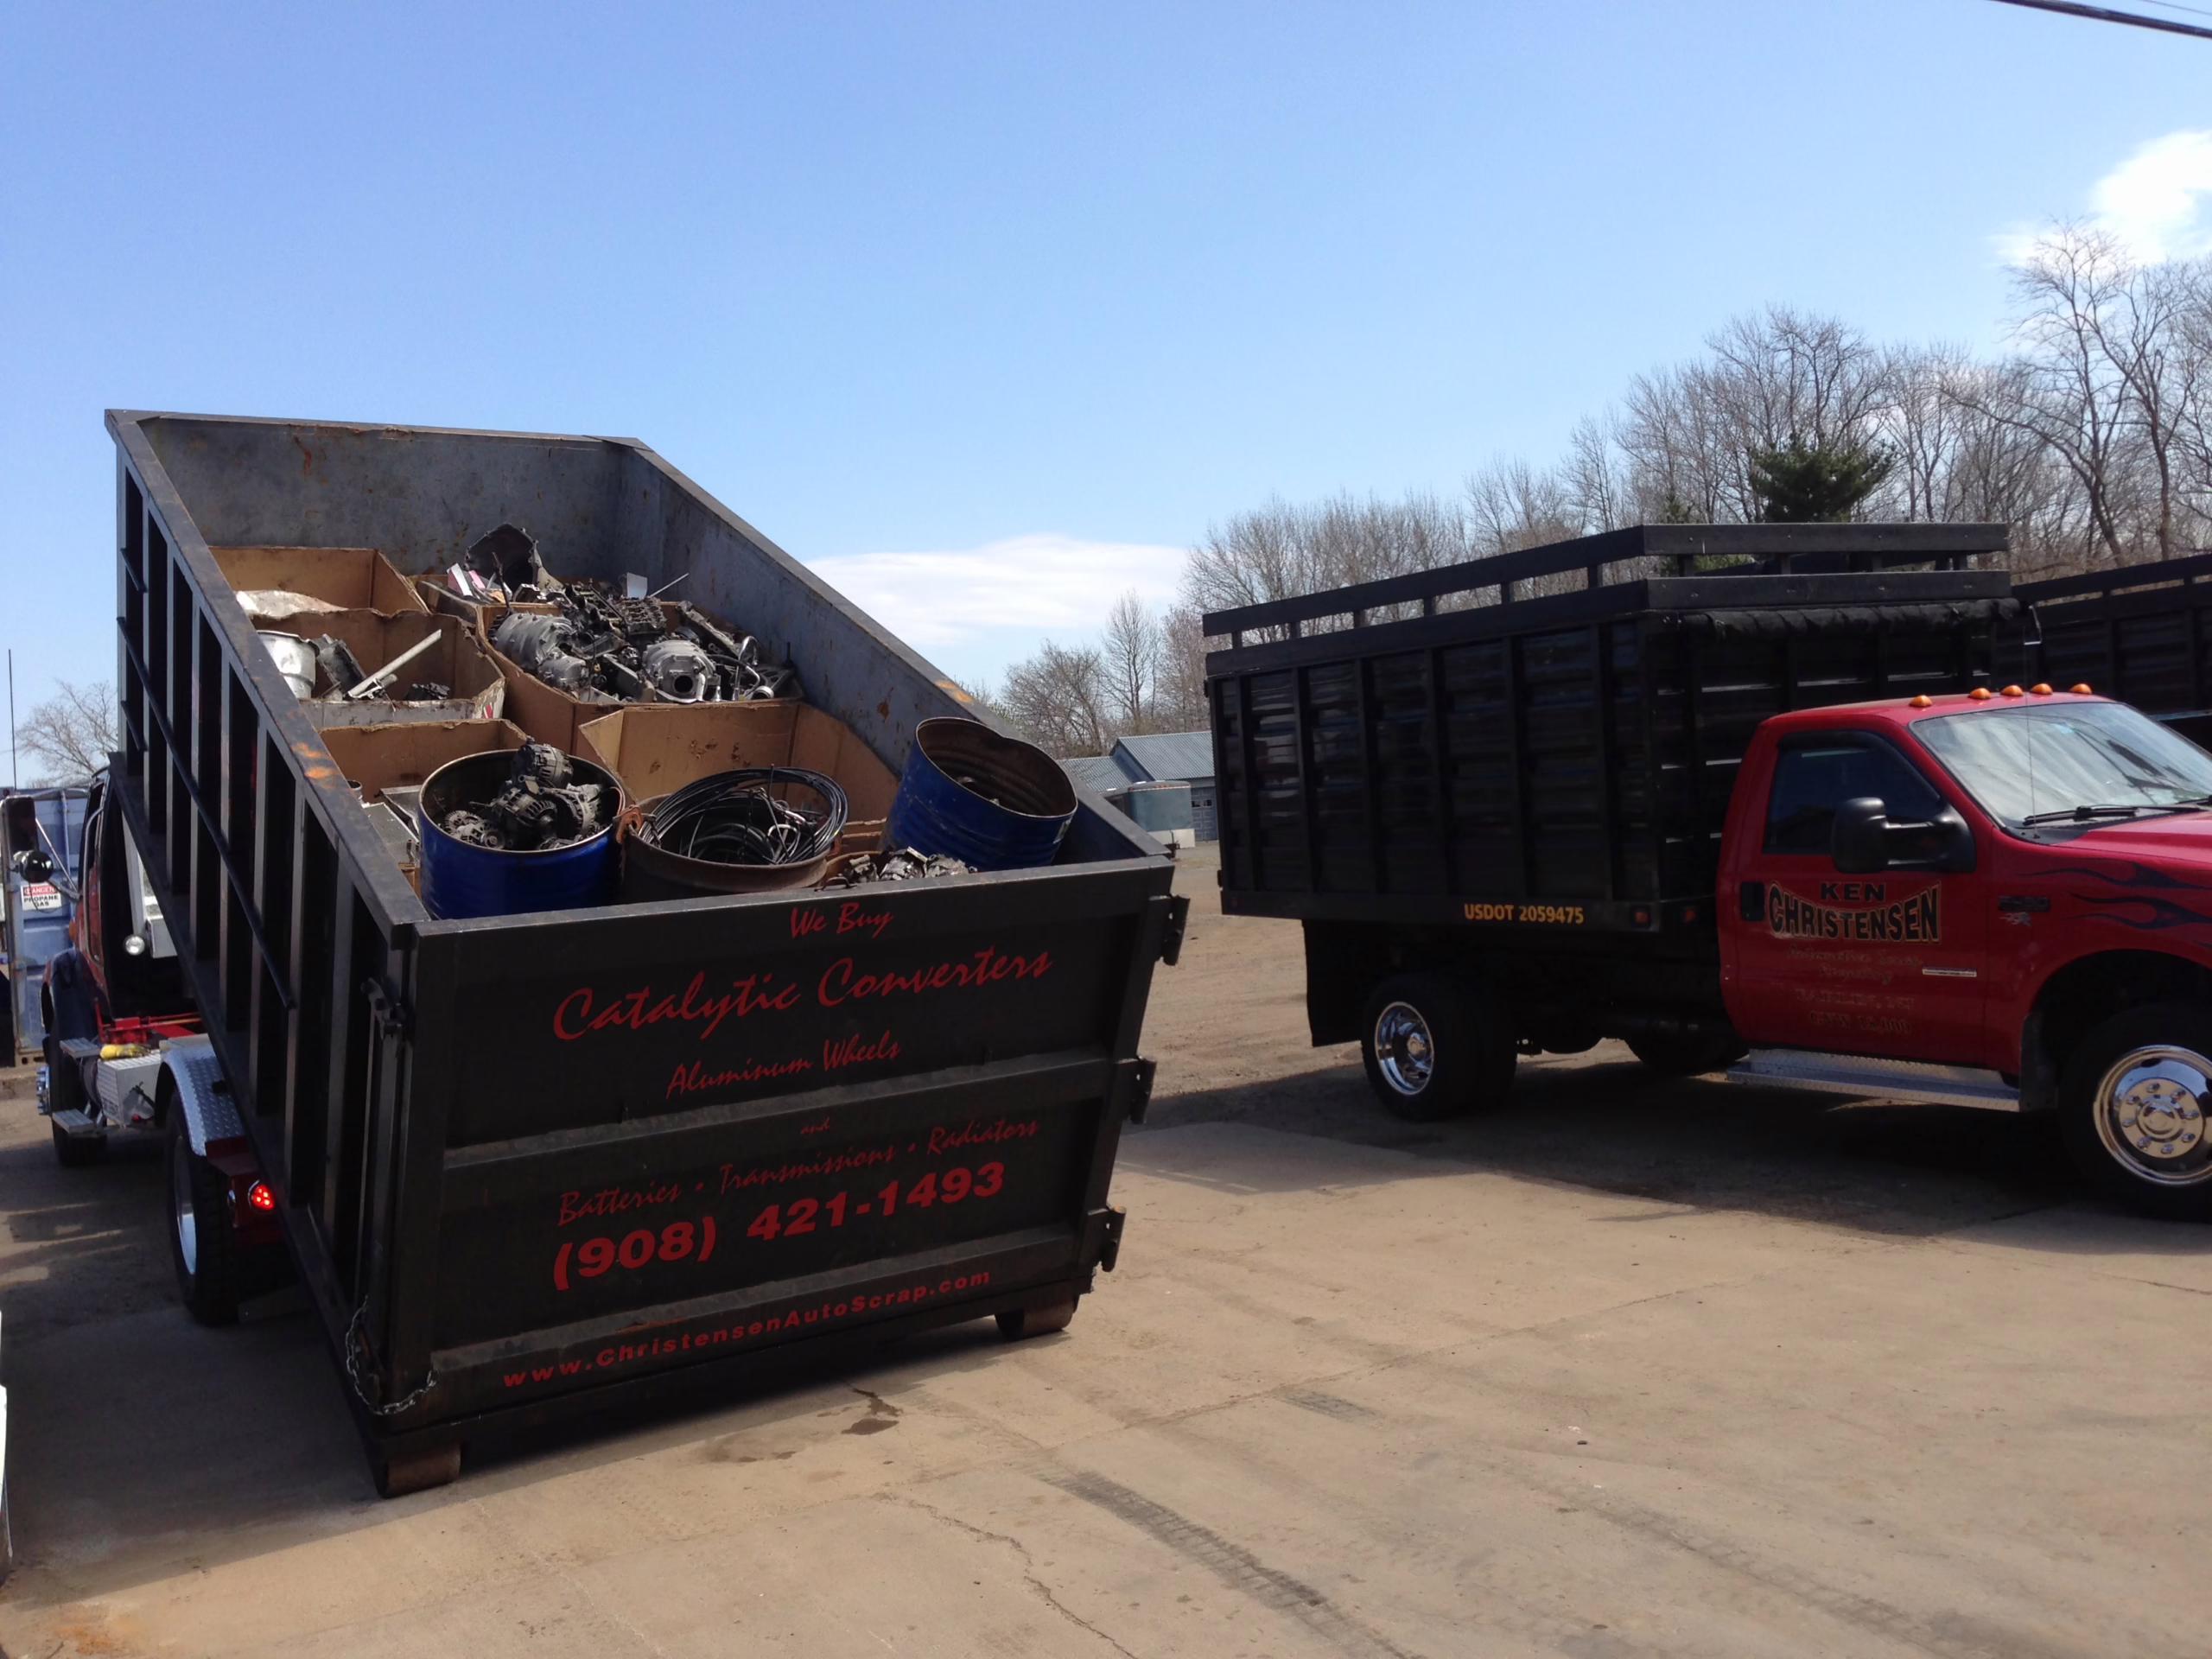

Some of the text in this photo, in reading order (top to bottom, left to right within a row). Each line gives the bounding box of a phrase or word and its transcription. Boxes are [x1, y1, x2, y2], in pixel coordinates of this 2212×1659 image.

[791, 901, 895, 938] We Buy
[1464, 904, 1585, 925] USDOT 2059475
[1769, 880, 1942, 944] CHRISTENSEN
[1821, 881, 1886, 902] KEN
[552, 946, 1054, 1040] Catalytic Converters
[666, 1029, 901, 1100] Aluminum Wheels
[800, 1118, 831, 1135] and
[557, 1120, 1039, 1228] Batteries Transmissions Radiators
[553, 1160, 1007, 1292] (908) 421-1493
[502, 1271, 992, 1389] www.ChristensenAutoScrap.com
